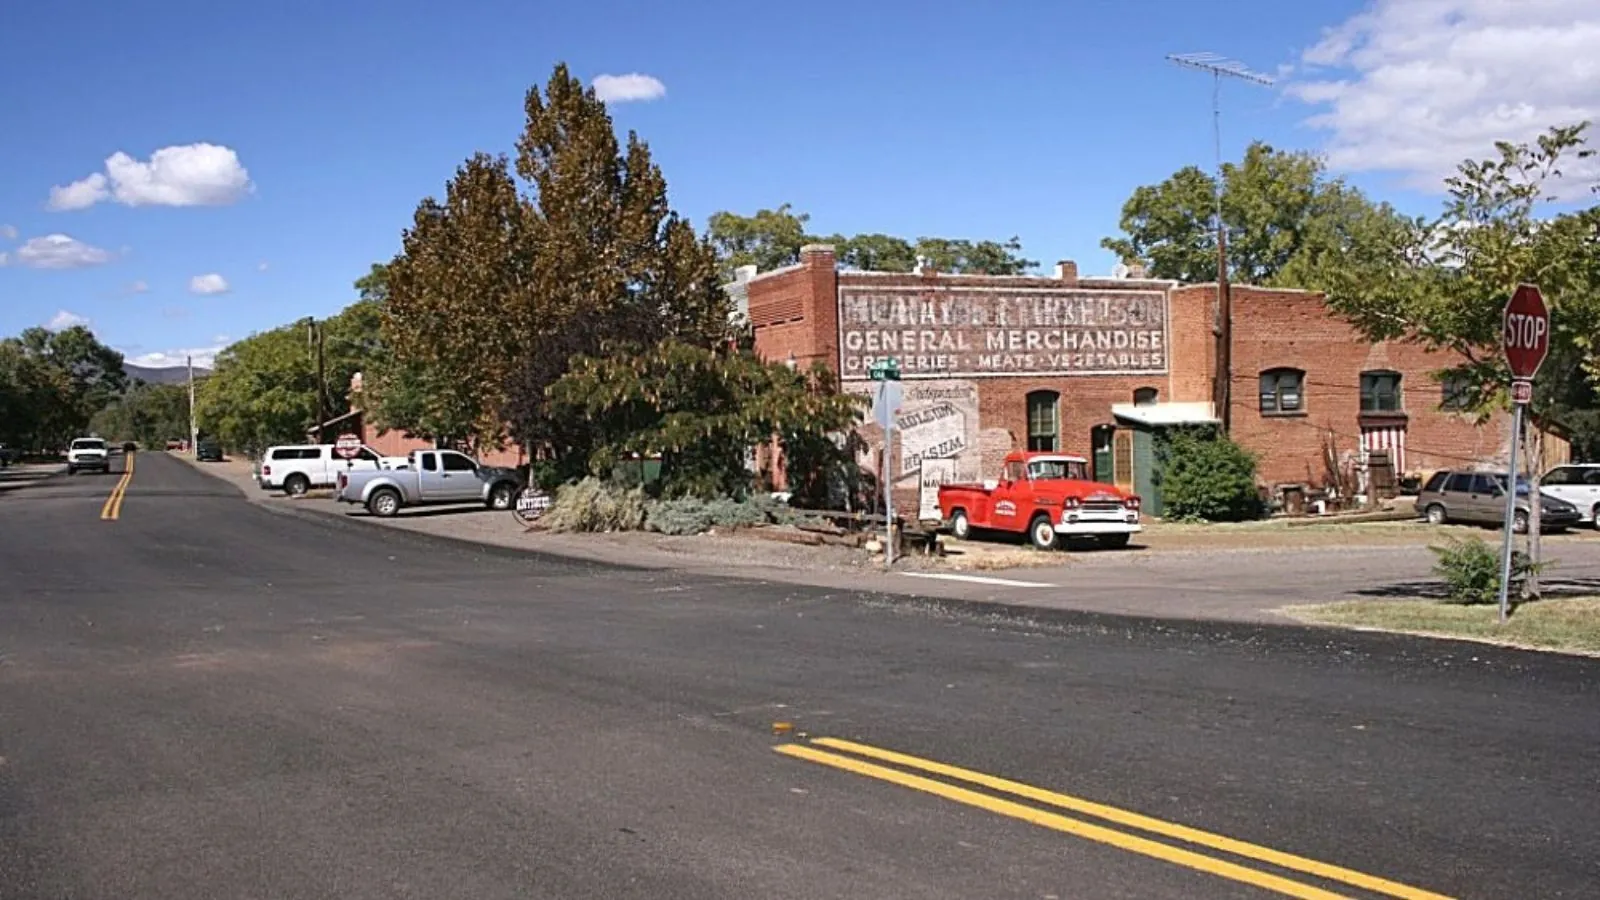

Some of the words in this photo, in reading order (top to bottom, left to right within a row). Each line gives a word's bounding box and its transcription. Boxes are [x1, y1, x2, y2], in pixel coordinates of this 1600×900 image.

[846, 329, 971, 351] GENERAL
[986, 329, 1162, 350] MERCHANDISE
[1506, 313, 1545, 349] STOP
[978, 354, 1034, 368] MEATS
[1048, 353, 1161, 367] VEGETABLES
[897, 403, 956, 430] HOLSUM
[904, 436, 965, 470] HOLSUM
